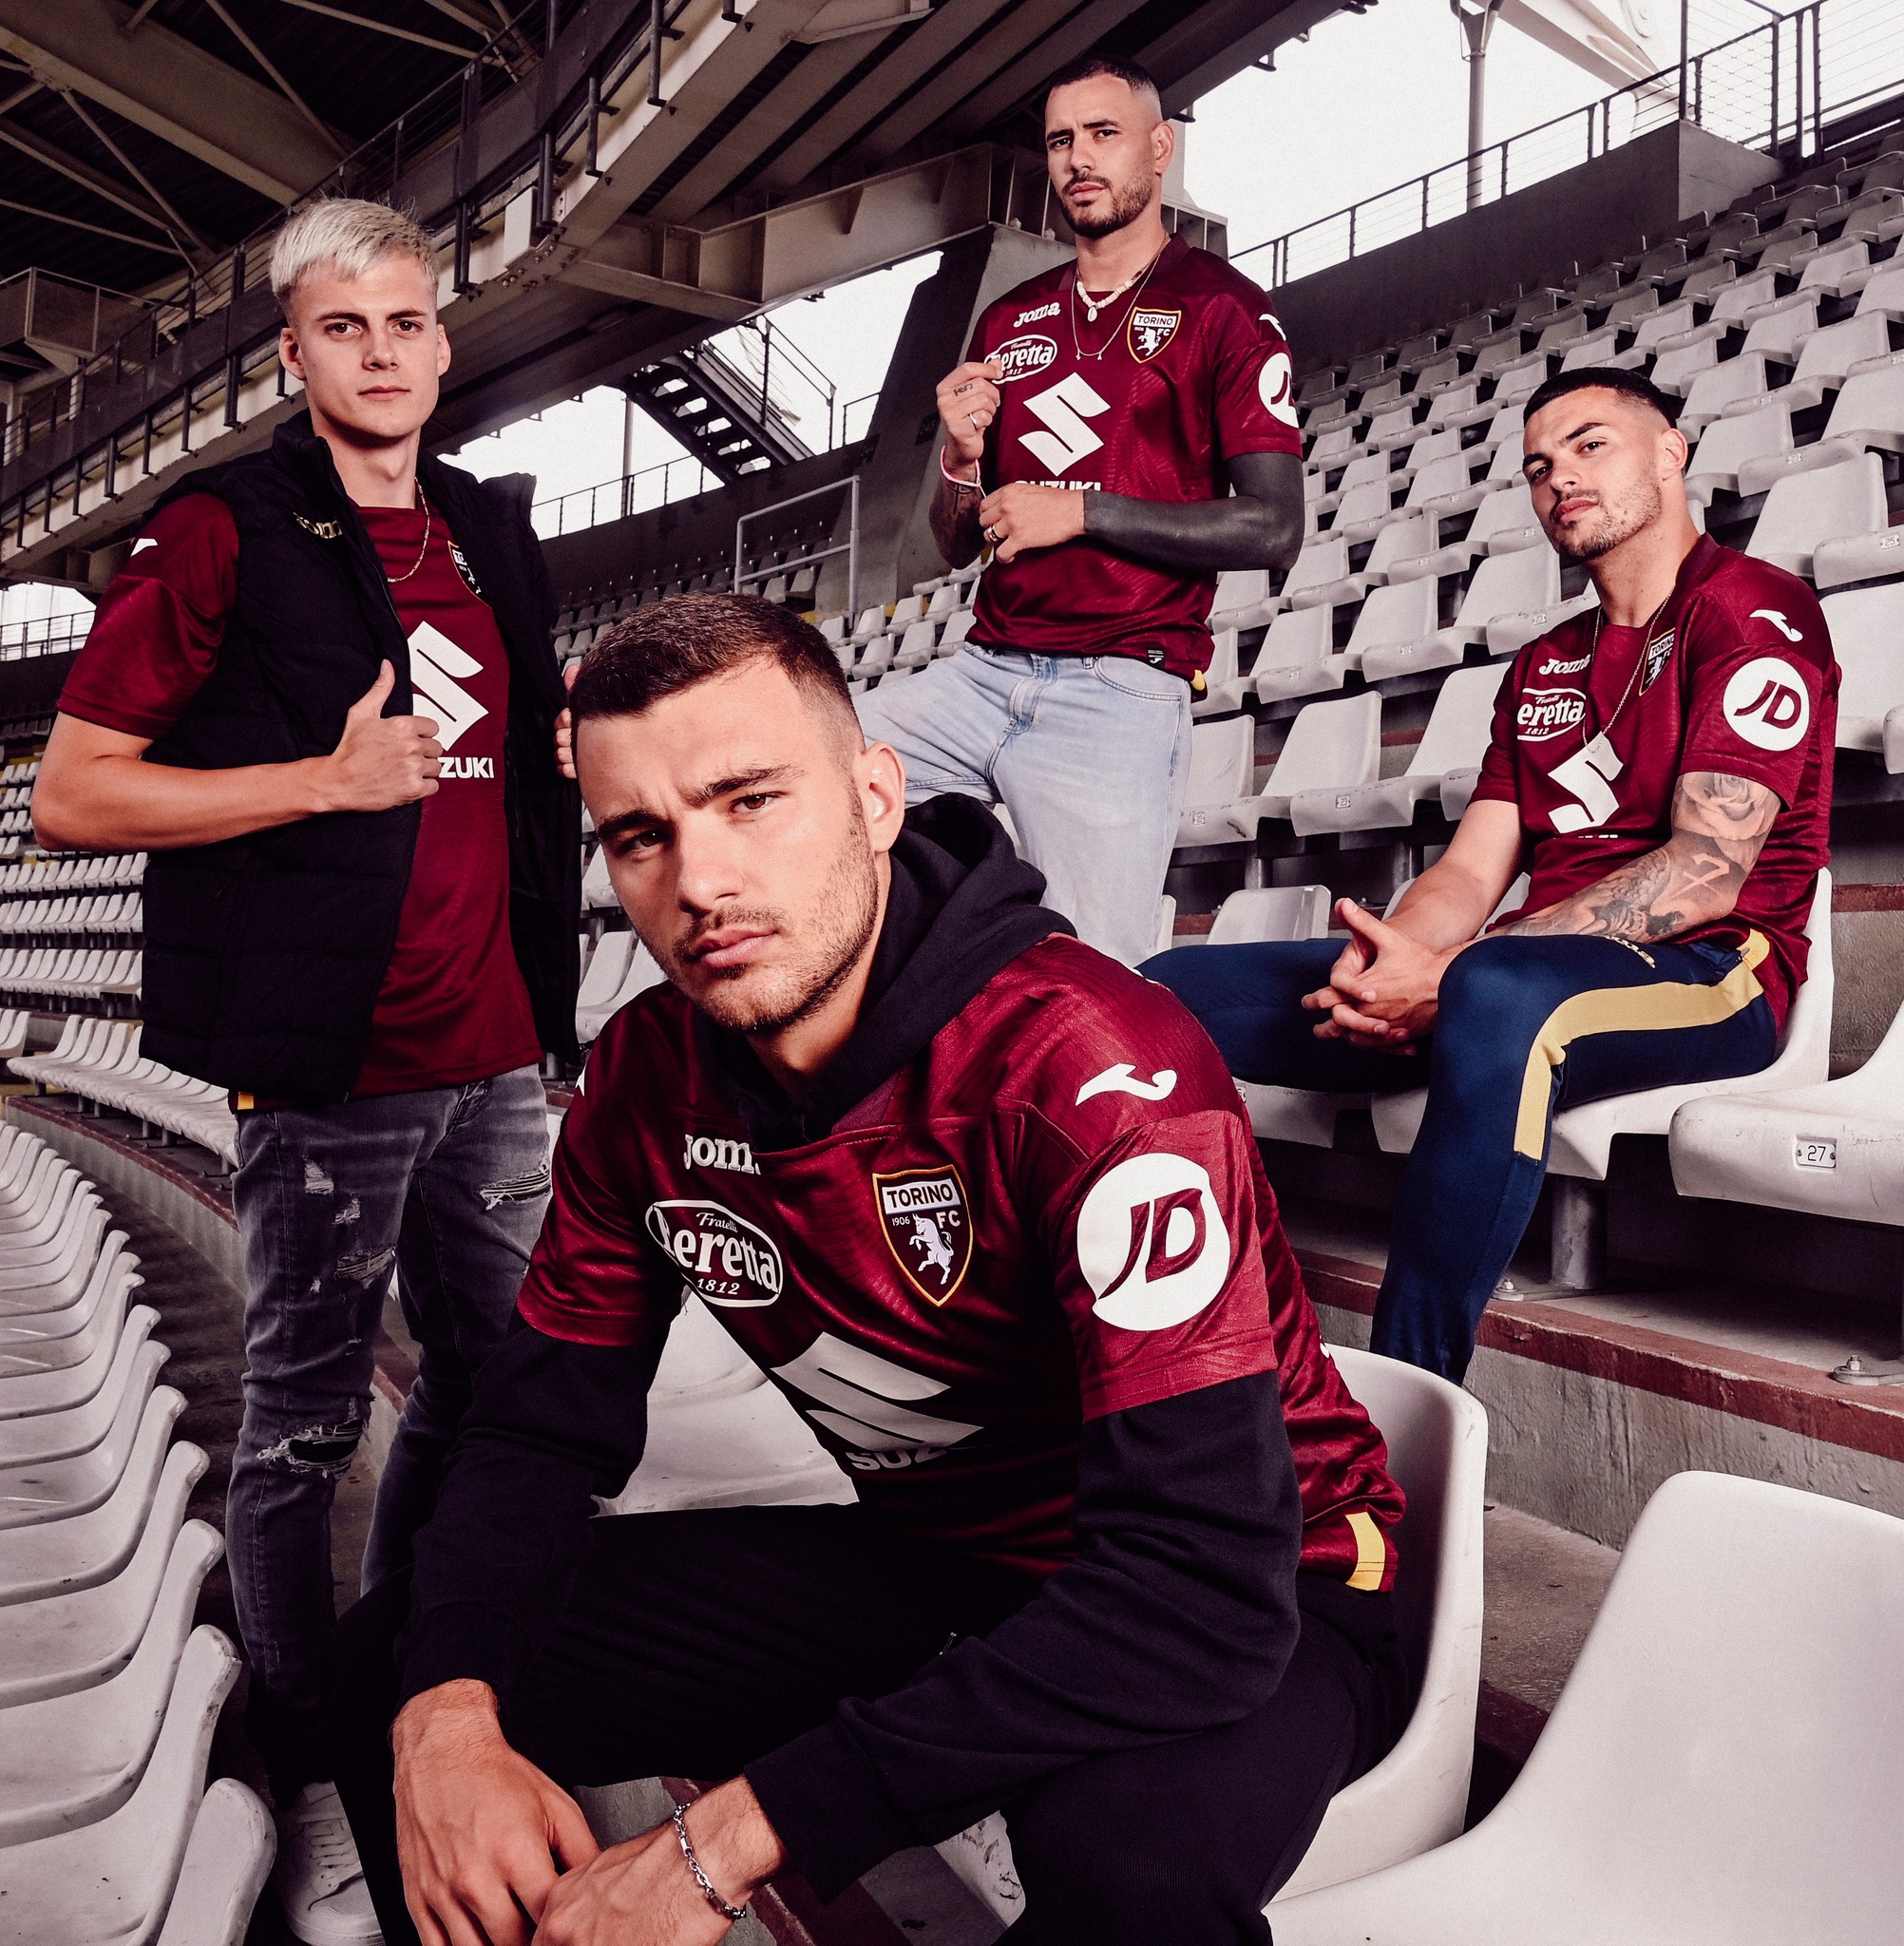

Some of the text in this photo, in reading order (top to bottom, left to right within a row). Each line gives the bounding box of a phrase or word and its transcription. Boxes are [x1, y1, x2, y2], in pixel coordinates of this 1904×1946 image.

[1013, 302, 1060, 328] Joma
[1138, 315, 1173, 326] TORINO
[1156, 328, 1171, 336] FC
[991, 344, 1054, 371] eretta
[1733, 679, 1802, 730] JD
[1524, 727, 1550, 735] 1812
[437, 756, 495, 779] ZUKI
[683, 1134, 761, 1176] Jom
[1807, 1144, 1827, 1162] 27
[886, 1183, 953, 1209] TORINO
[695, 1211, 738, 1233] Fratelli
[891, 1215, 911, 1227] 1906
[936, 1210, 962, 1229] FC
[1097, 1188, 1207, 1300] JD
[697, 1278, 740, 1296] 1812
